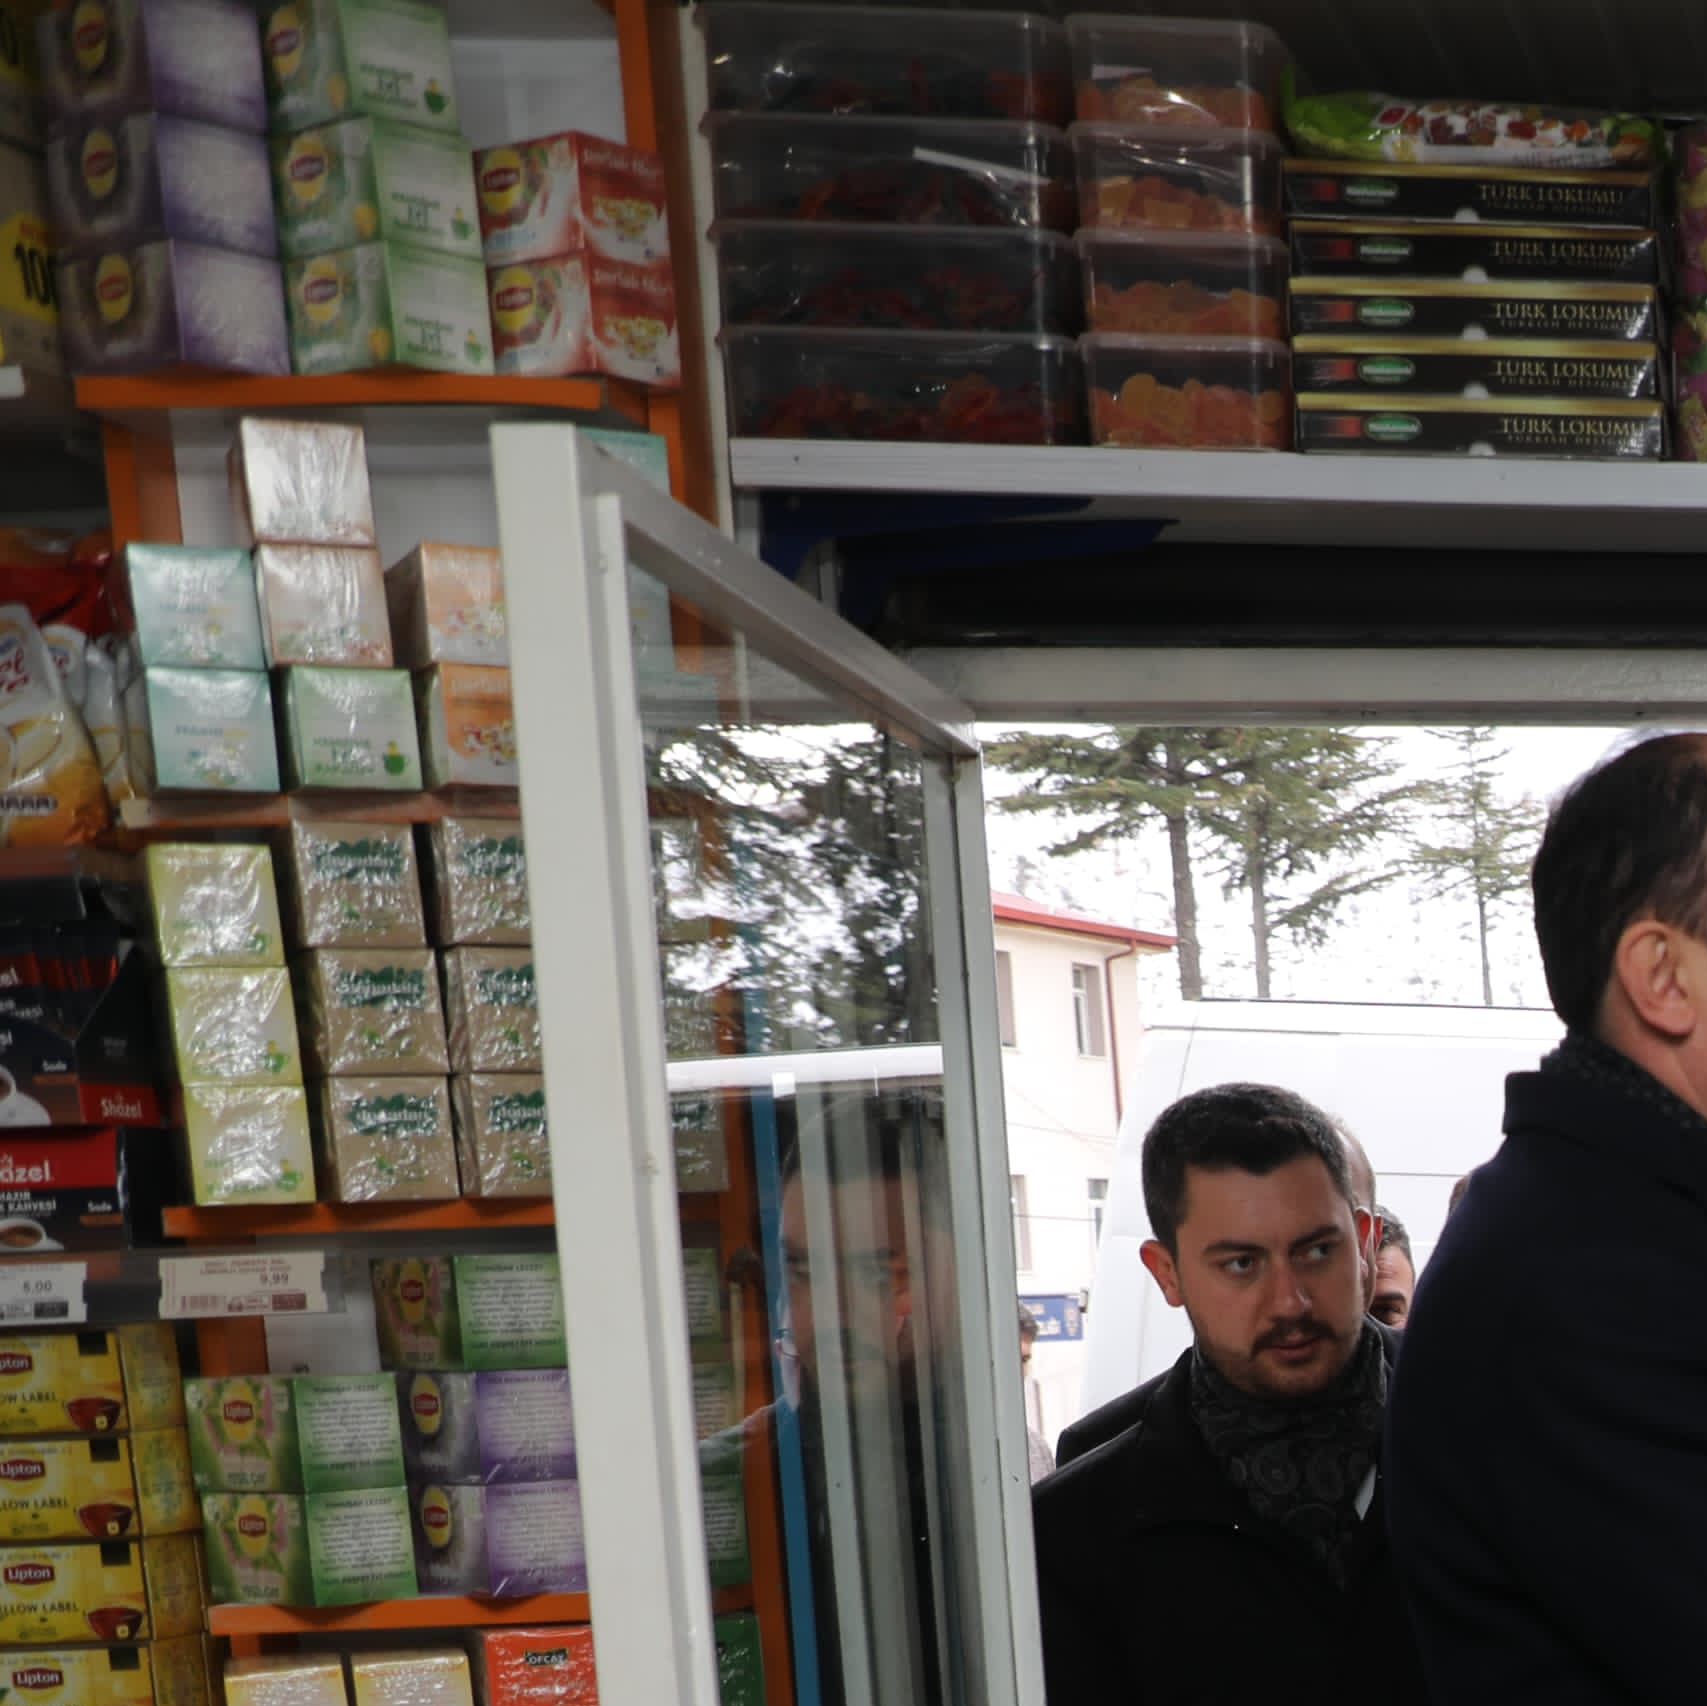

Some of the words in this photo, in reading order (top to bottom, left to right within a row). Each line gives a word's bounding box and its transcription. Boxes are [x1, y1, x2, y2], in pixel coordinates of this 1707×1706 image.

[1551, 303, 1637, 322] LOKUMU
[1551, 361, 1639, 381] LOKUMU
[0, 1157, 55, 1184] azel
[0, 1356, 31, 1375] pton
[1, 1461, 43, 1479] Lipton
[9, 1565, 52, 1583] Lipton
[17, 1670, 62, 1688] Lipton
